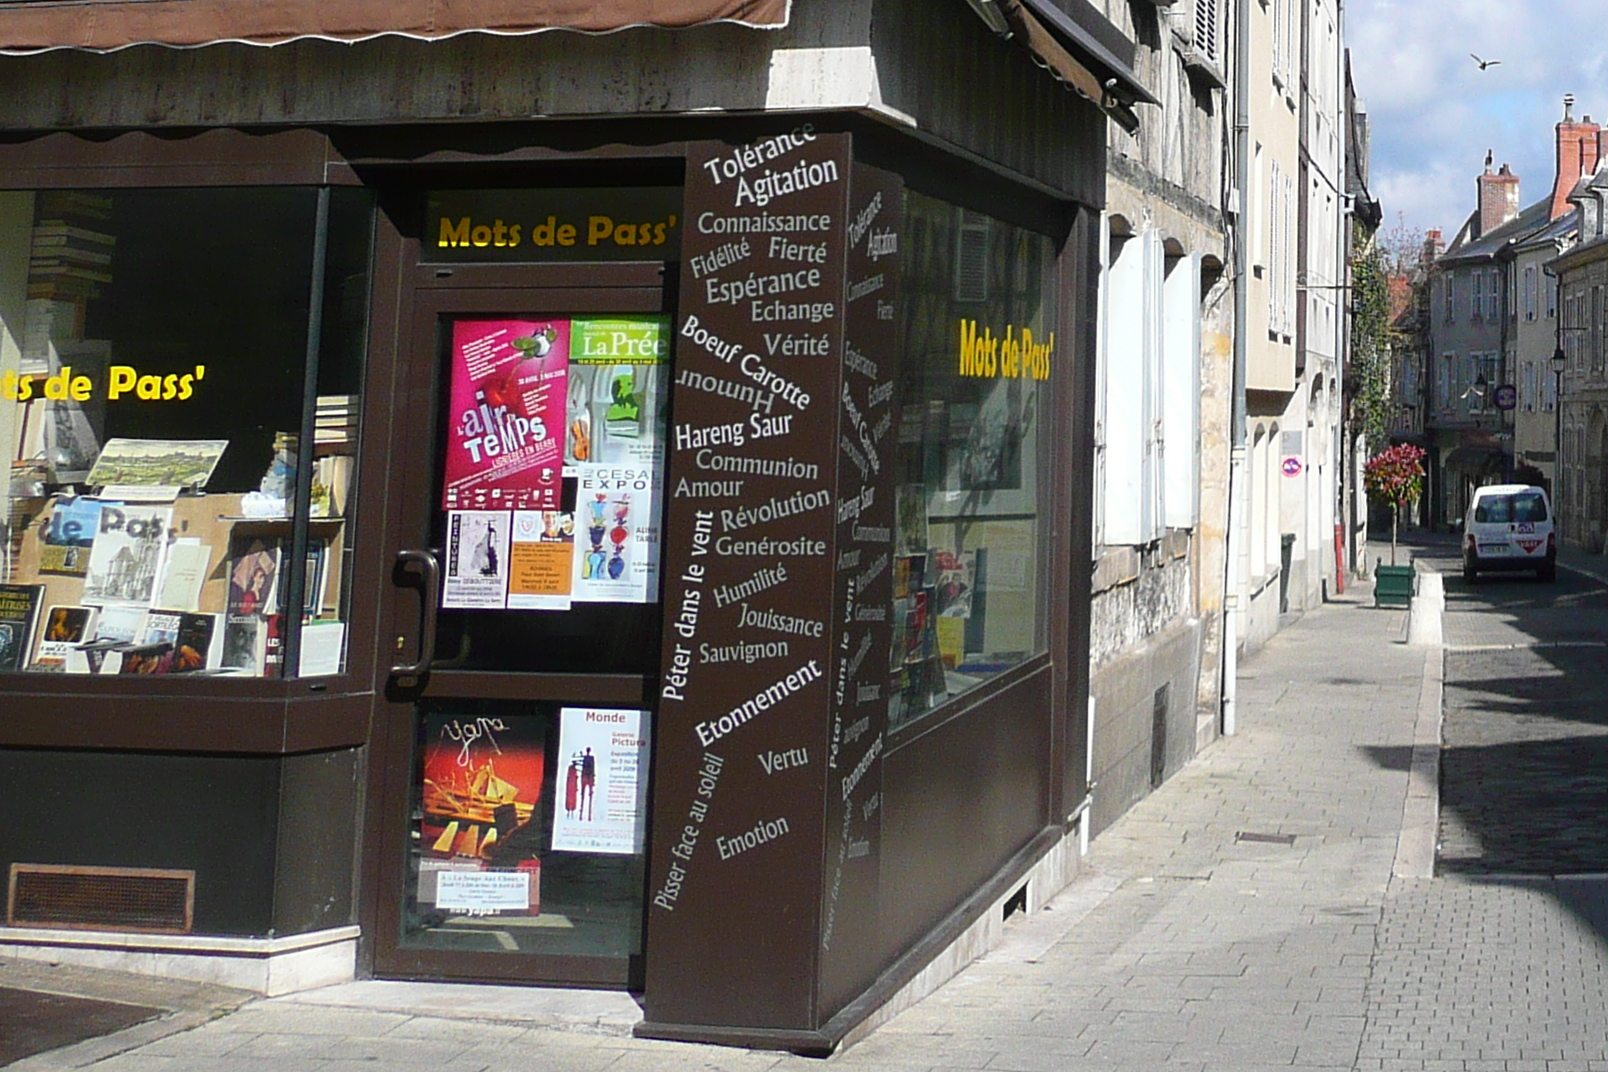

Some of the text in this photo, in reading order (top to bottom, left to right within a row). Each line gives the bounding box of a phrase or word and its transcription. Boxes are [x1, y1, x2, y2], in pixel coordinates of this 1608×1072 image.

[703, 123, 817, 185] Tolérance
[734, 157, 839, 207] Agitation
[438, 215, 677, 247] Mots de Pass'
[698, 211, 831, 234] Connaissance
[690, 236, 751, 279] Fidélité
[768, 236, 827, 264] Fierté
[705, 267, 820, 305] Espérance
[751, 299, 834, 324] Echange
[582, 331, 666, 356] La Prée
[763, 332, 830, 356] Vérité
[959, 318, 1054, 380] Mots de Pass'
[681, 315, 811, 410] Boeuf Carotte
[44, 366, 92, 401] de
[108, 365, 205, 400] Pass'
[675, 368, 775, 415] Humour
[675, 411, 792, 451] Hareng Saur
[695, 448, 818, 480] Communion
[583, 479, 646, 490] EXPO
[674, 477, 744, 498] Amour
[720, 488, 830, 532] Révolution
[713, 562, 788, 608] Humilité
[662, 510, 714, 702] Péter dans le vent
[737, 603, 823, 638] Jouissance
[699, 641, 789, 664] Sauvignon
[586, 711, 627, 724] Monde
[695, 658, 823, 748] Etonnement
[611, 737, 647, 747] Pictura
[757, 747, 808, 776] Vertu
[654, 751, 725, 912] Pisser face au soleil
[715, 816, 790, 860] Emotion
